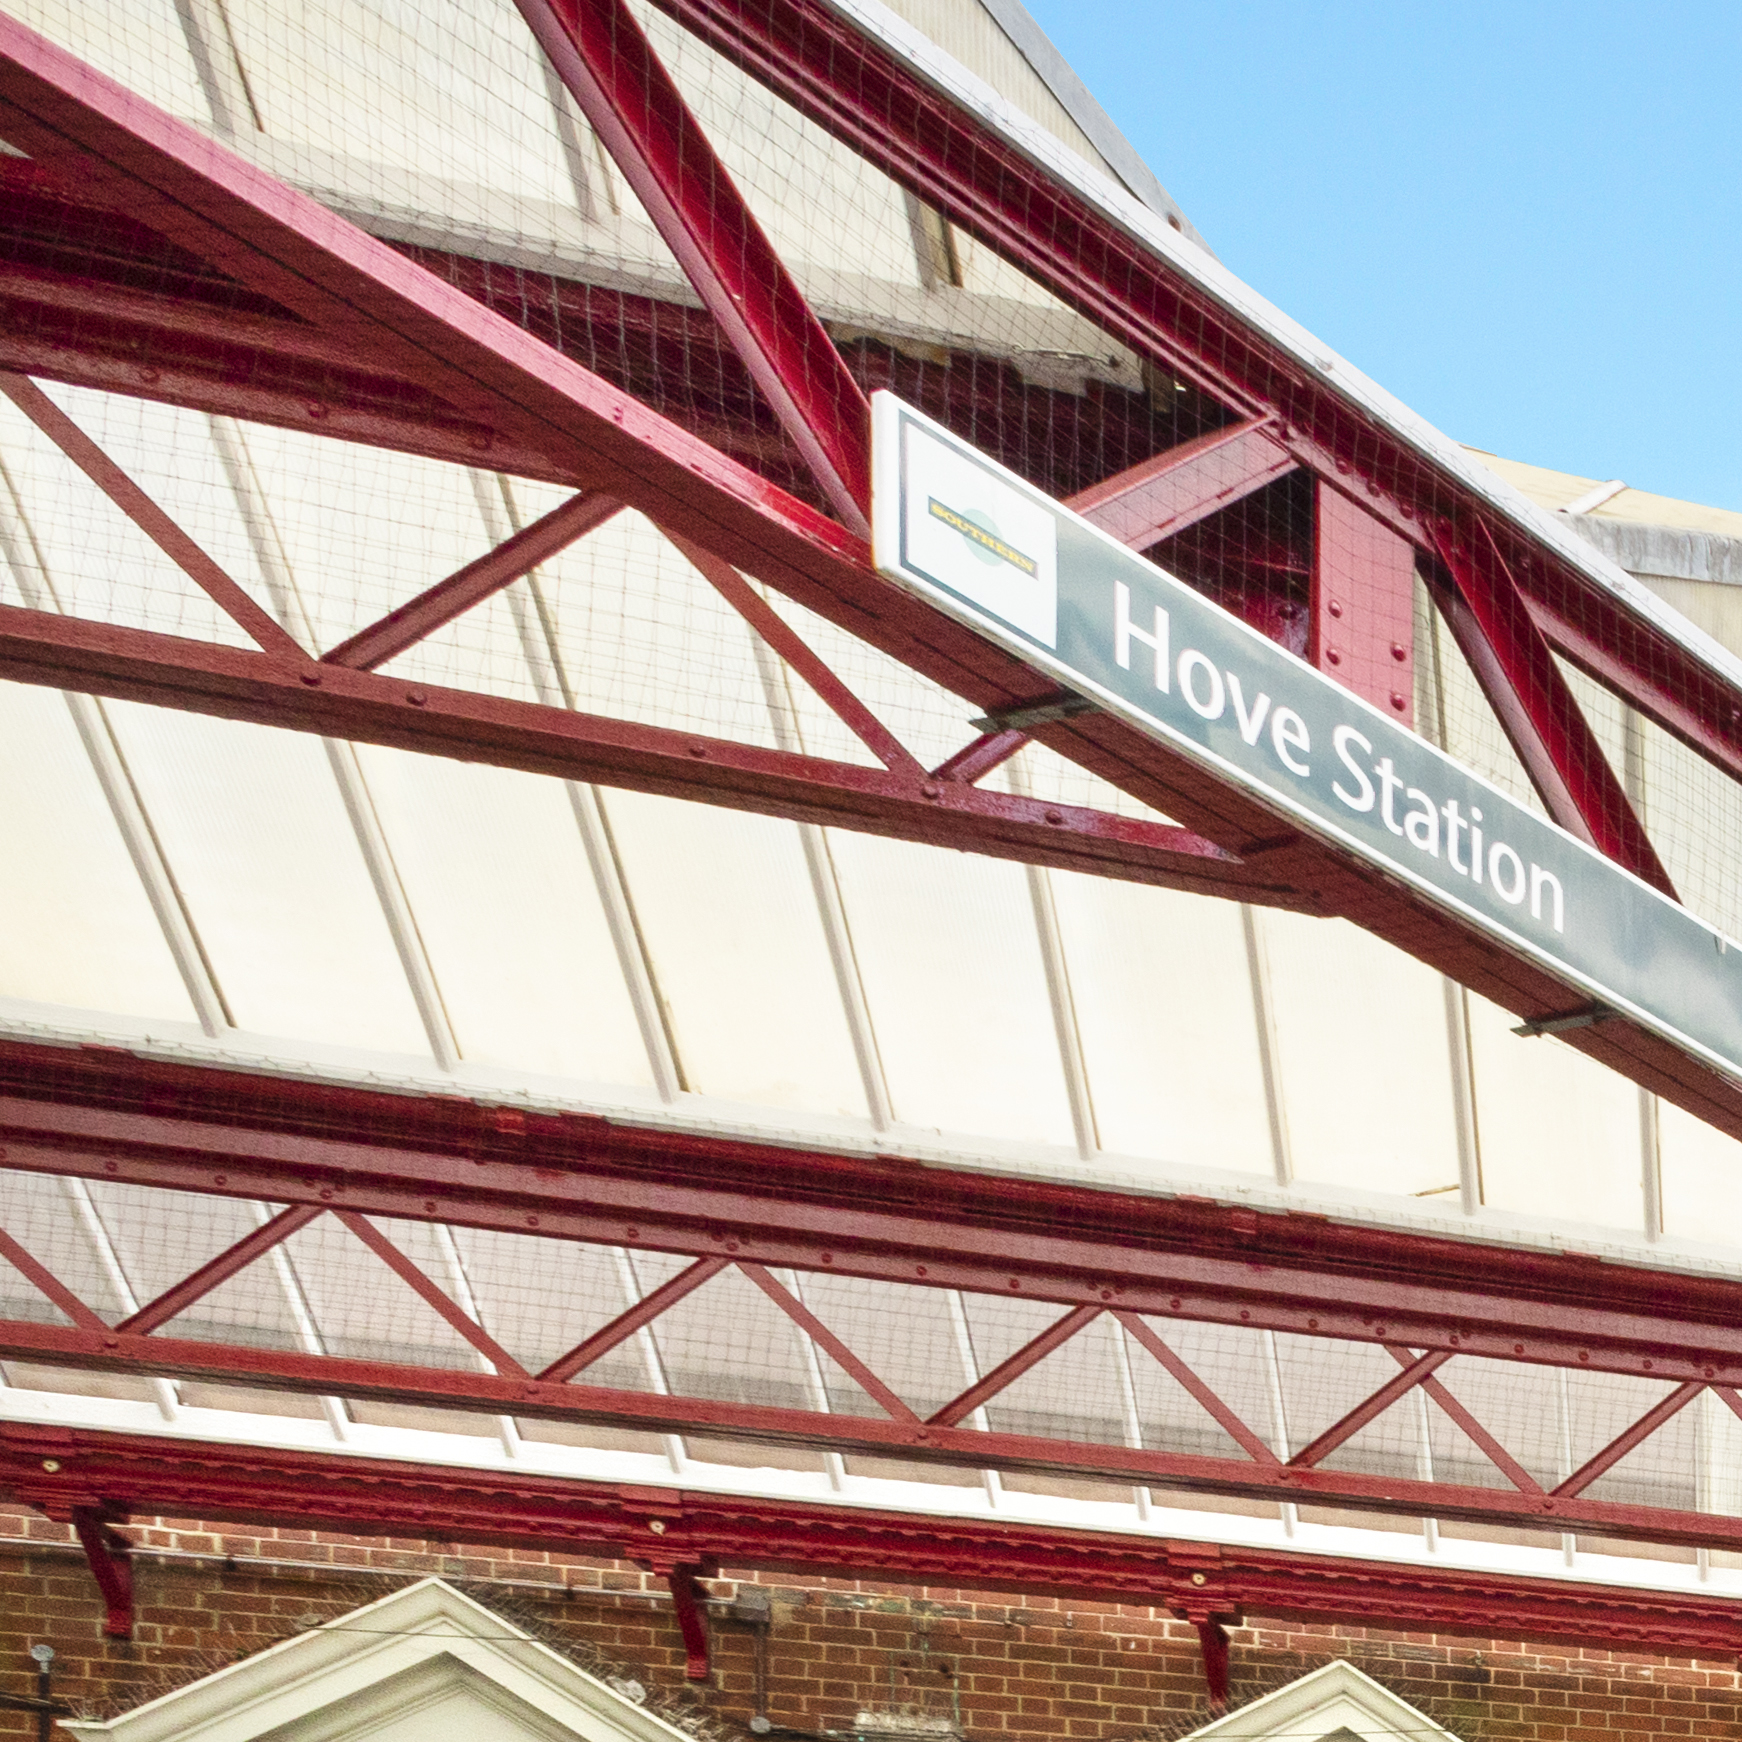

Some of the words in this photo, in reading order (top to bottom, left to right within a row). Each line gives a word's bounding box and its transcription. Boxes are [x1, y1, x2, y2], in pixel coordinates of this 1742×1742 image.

[930, 502, 1034, 572] SOUTHERN
[1114, 580, 1310, 777] Hove
[1331, 724, 1564, 934] Station
